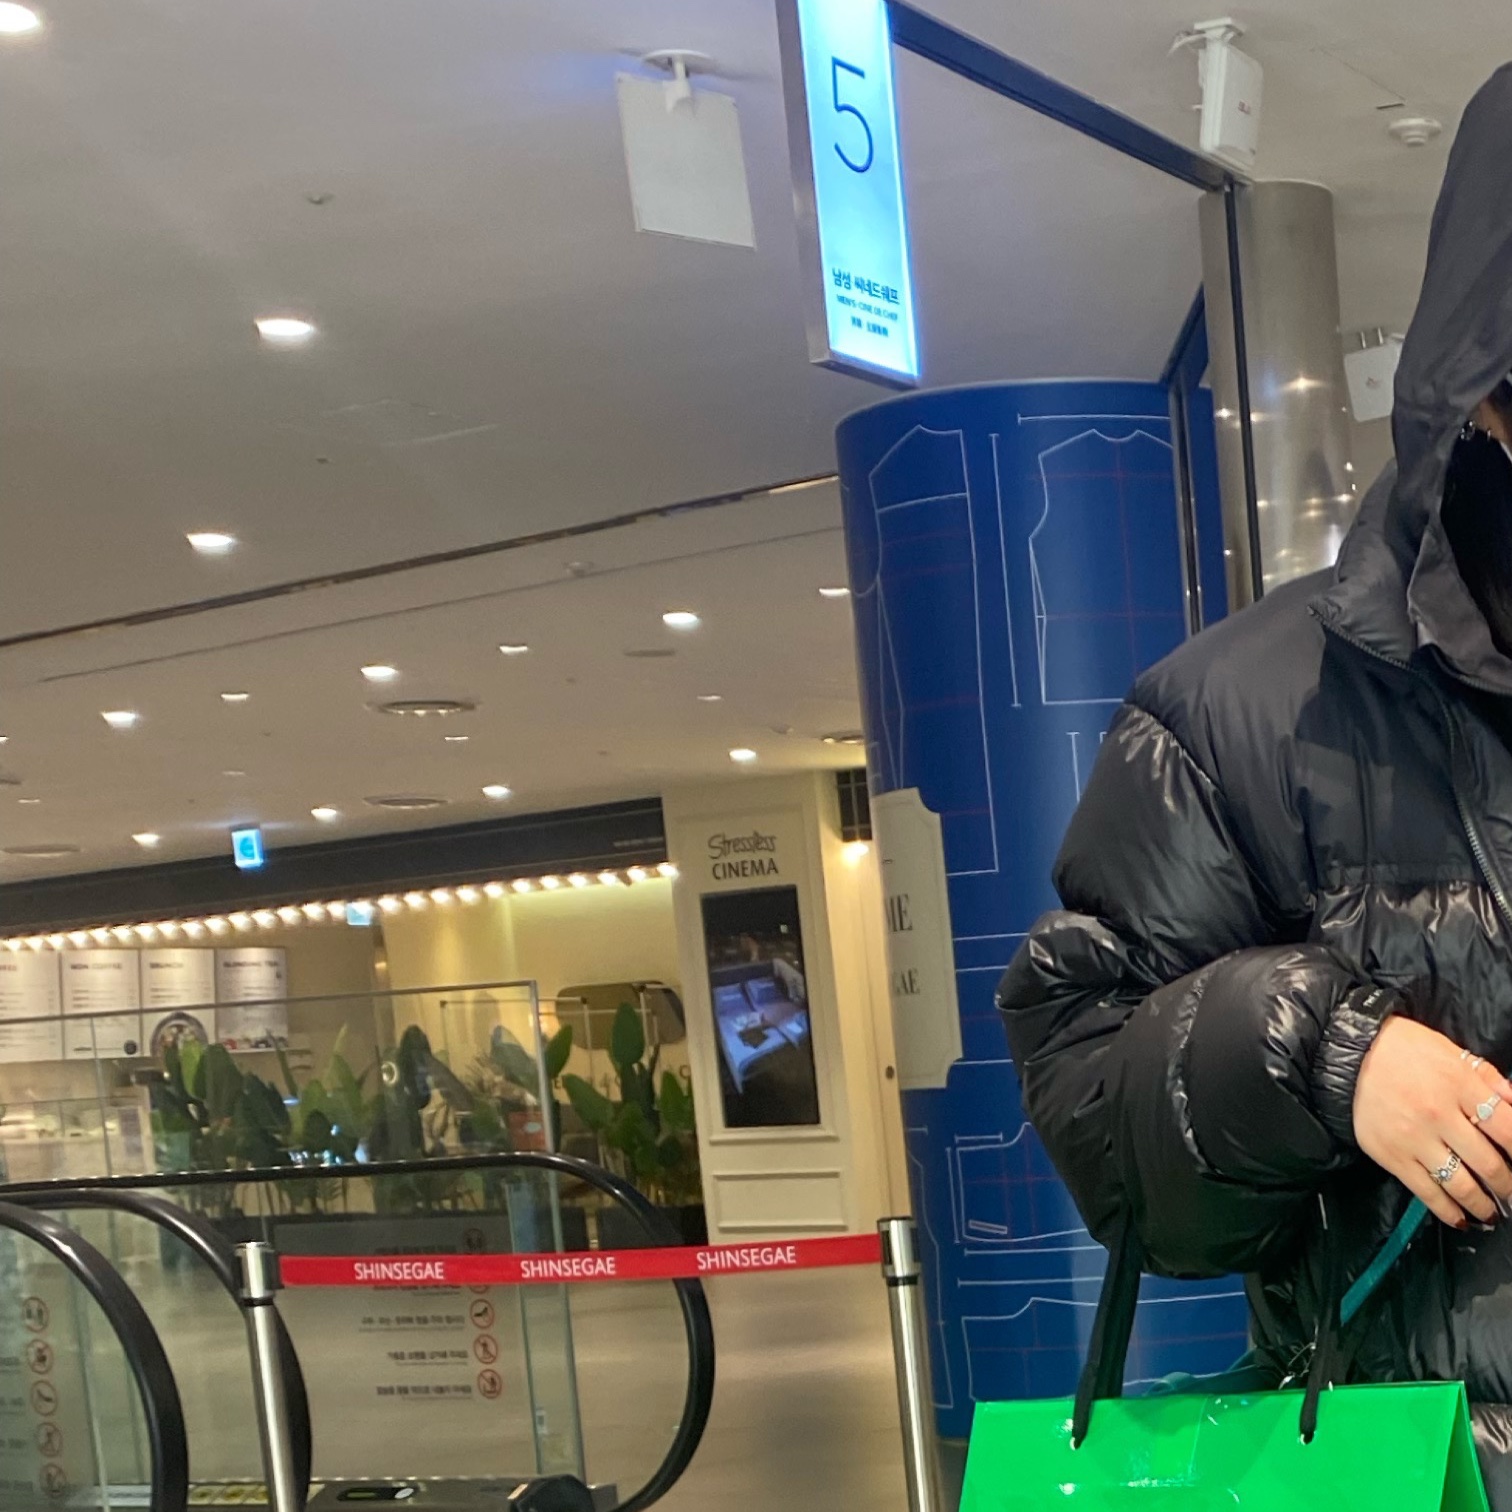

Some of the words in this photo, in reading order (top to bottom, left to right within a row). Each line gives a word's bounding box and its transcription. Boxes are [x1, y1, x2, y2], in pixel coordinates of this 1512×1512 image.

[831, 56, 873, 173] 5
[832, 267, 851, 291] 남성
[712, 858, 779, 880] CINEMA
[353, 1262, 445, 1281] SHINSEGAE
[520, 1257, 616, 1278] SHINSEGAE
[696, 1246, 797, 1270] SHINSEGAE
